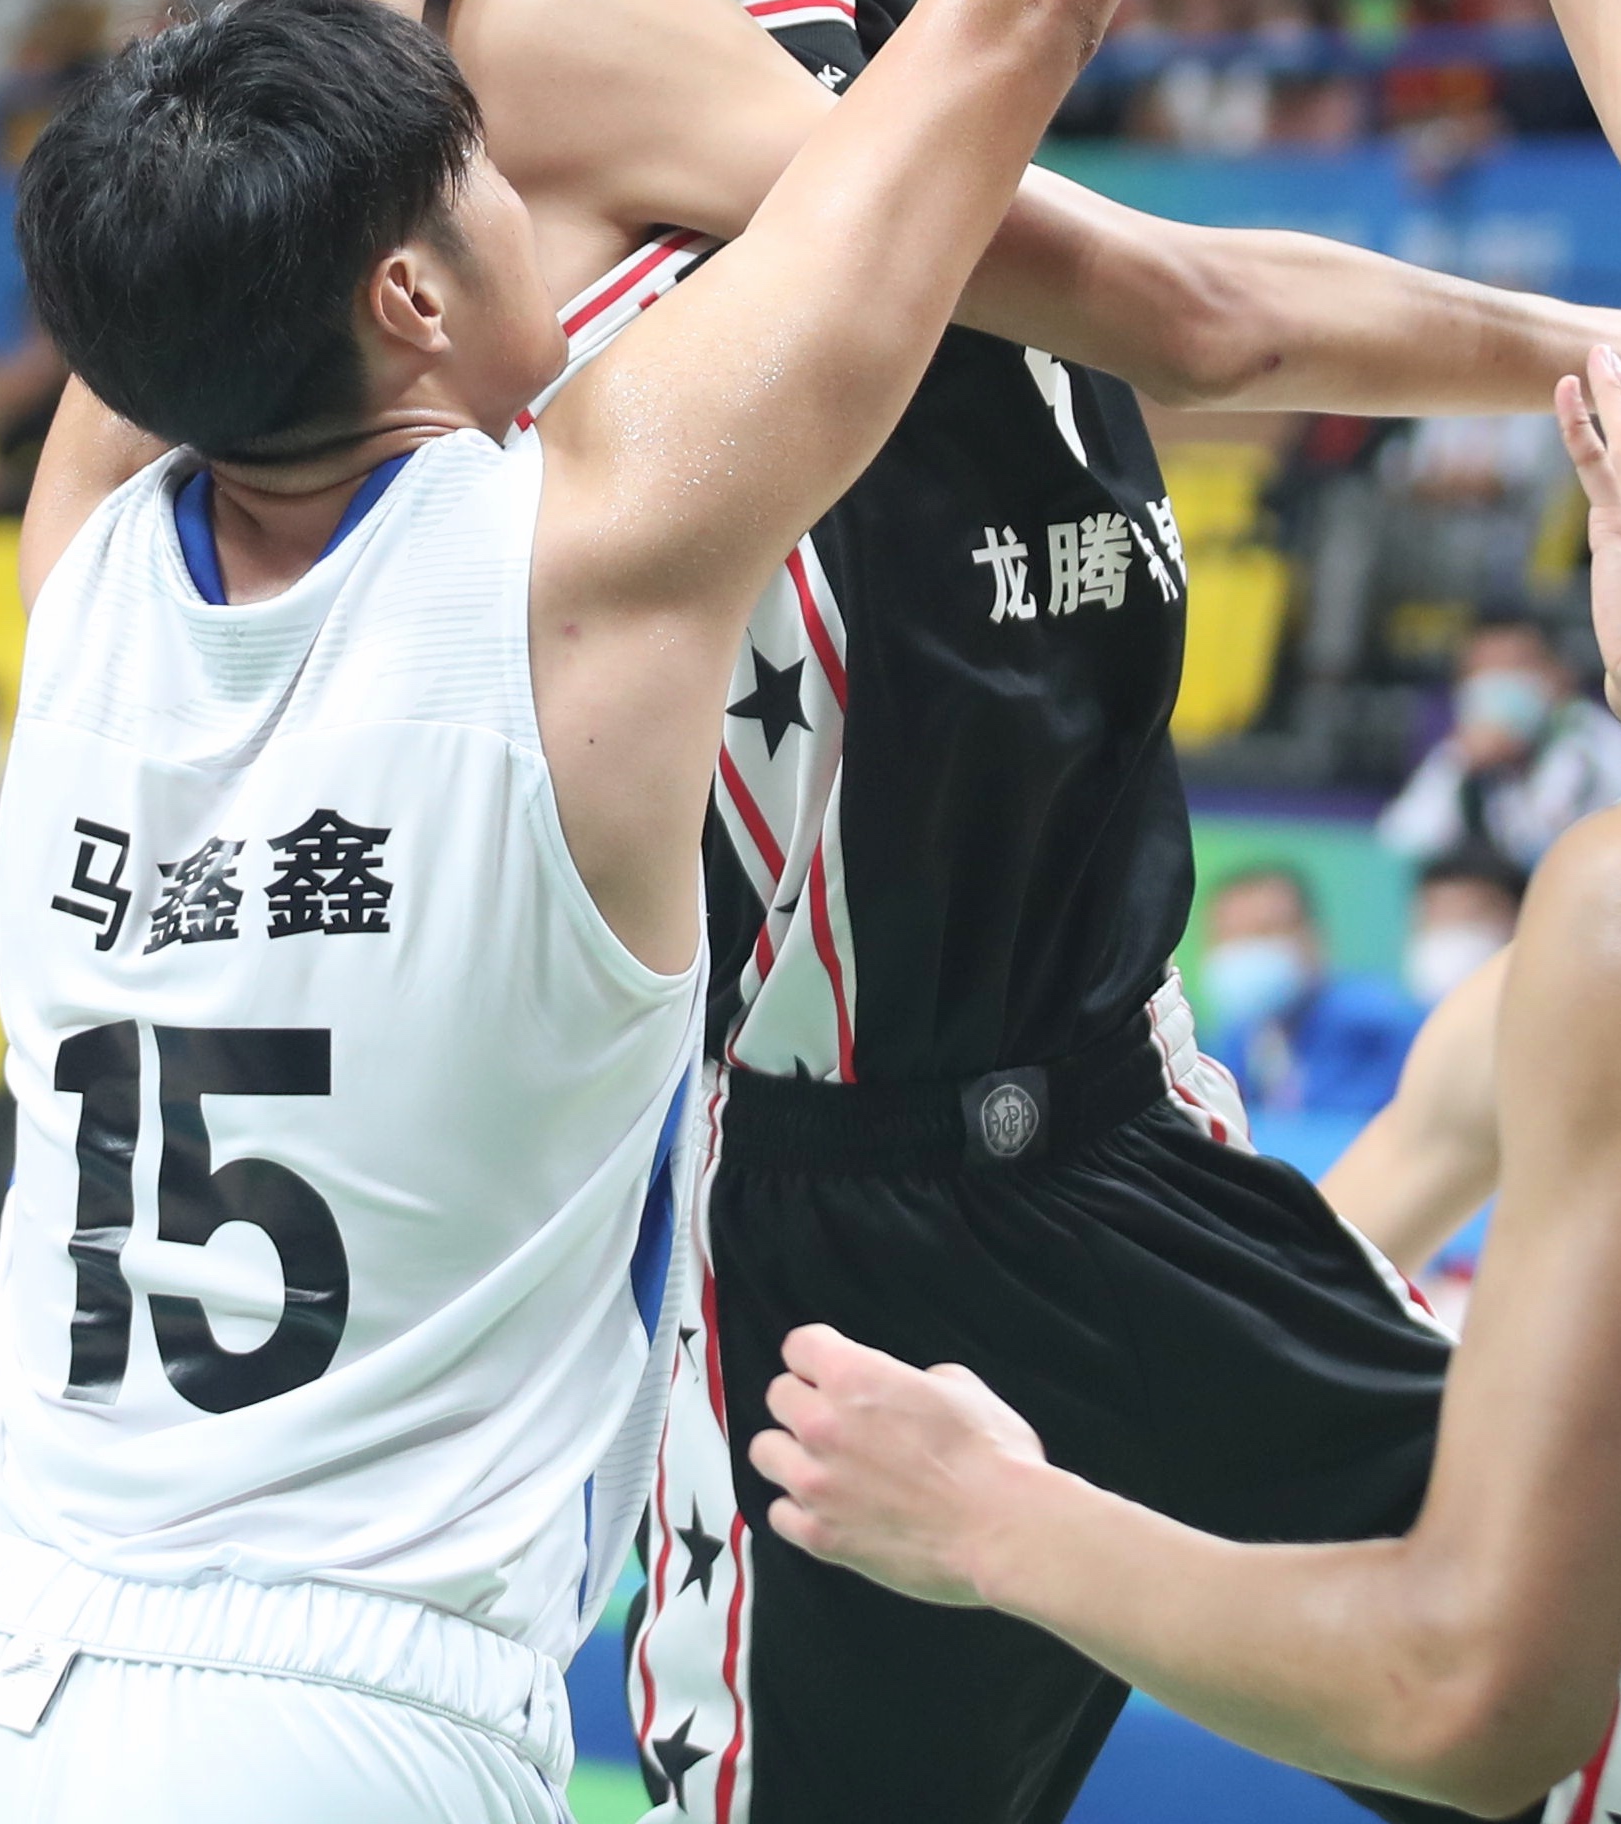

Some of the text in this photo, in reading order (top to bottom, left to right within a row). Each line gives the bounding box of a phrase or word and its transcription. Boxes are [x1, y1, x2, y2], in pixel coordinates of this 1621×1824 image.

[50, 808, 394, 956] 马鑫鑫
[53, 1018, 351, 1415] 15
